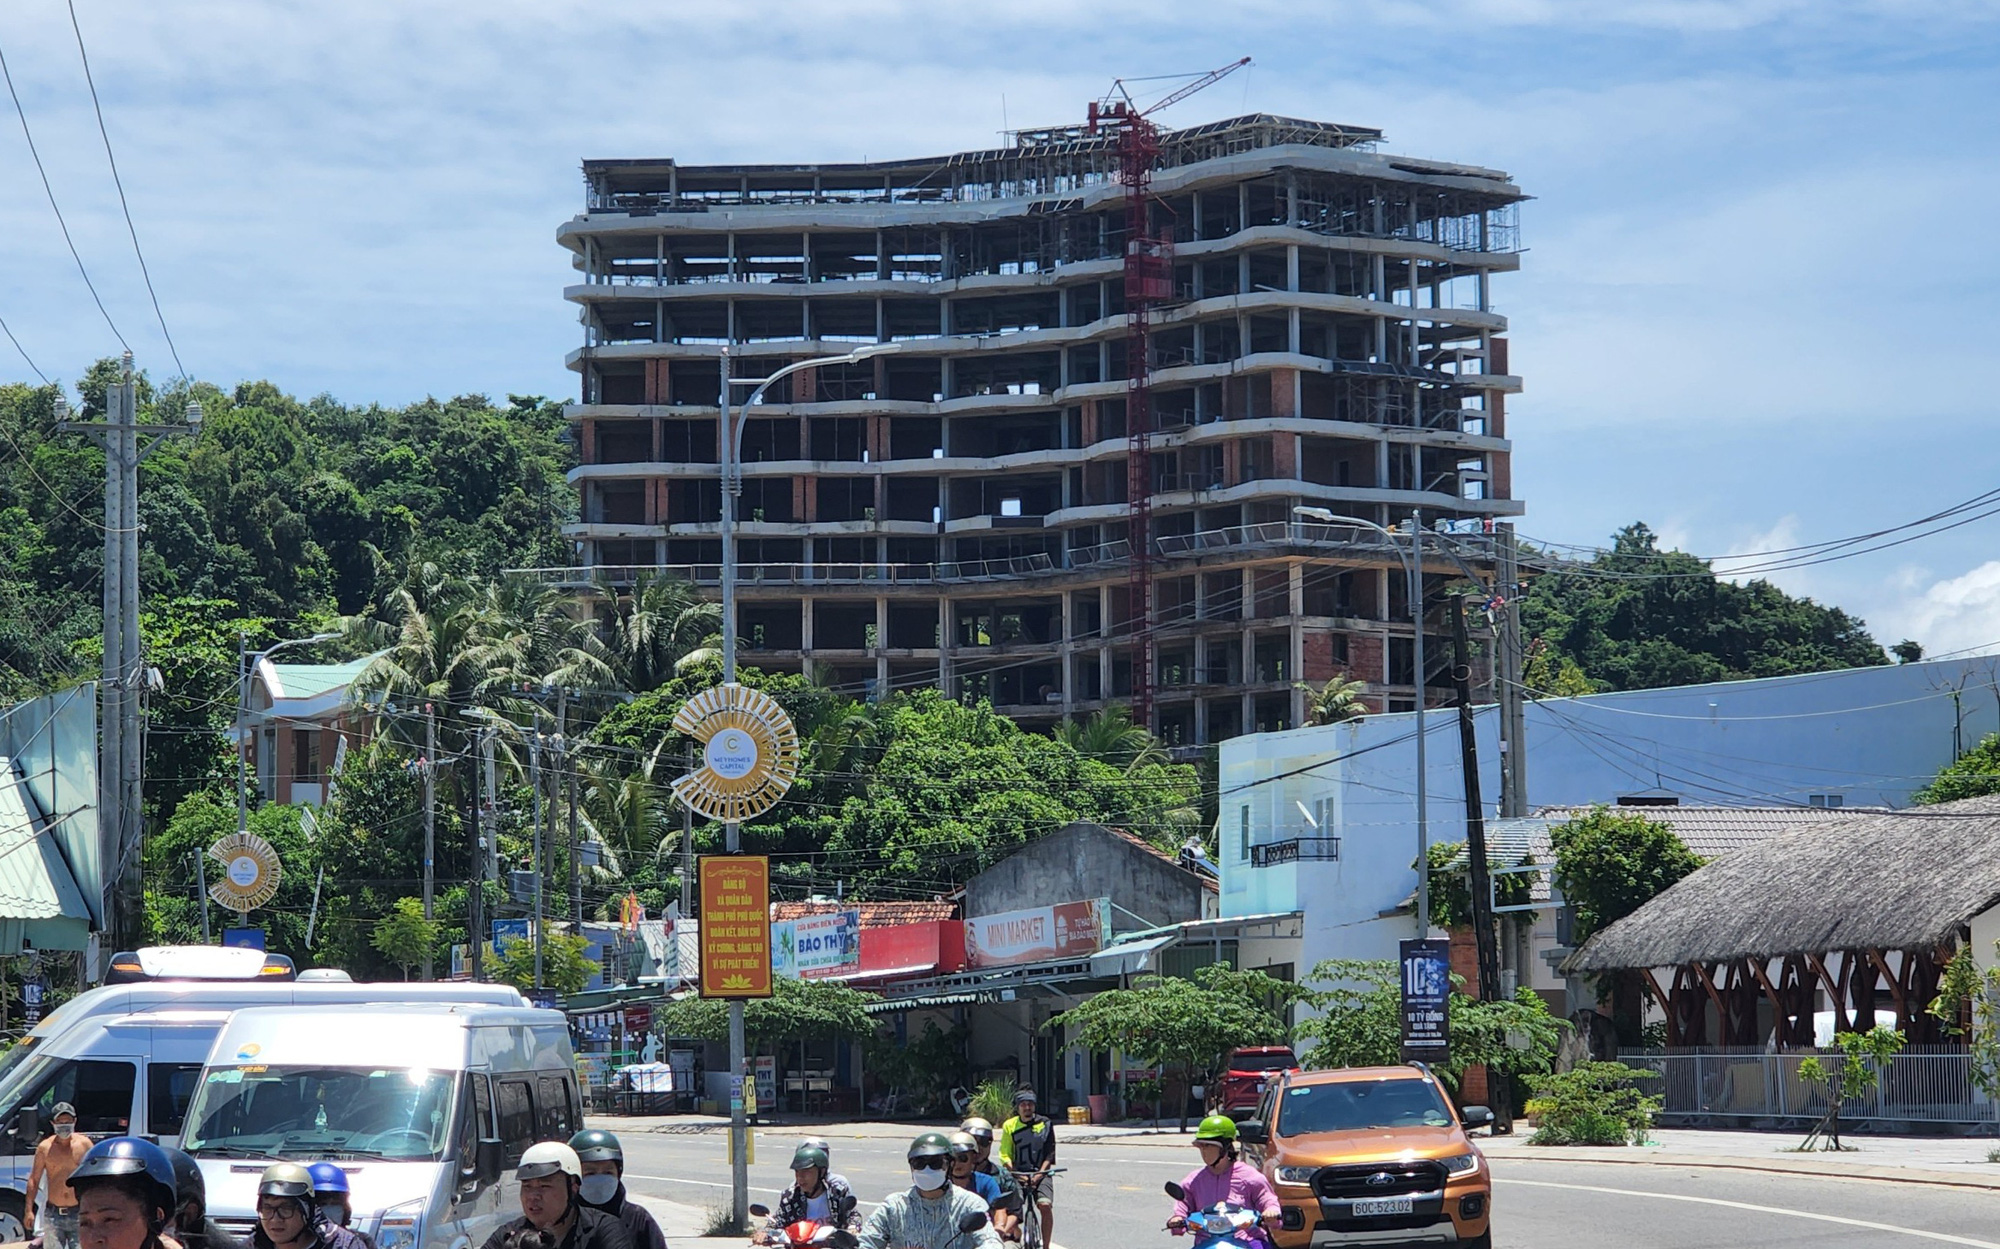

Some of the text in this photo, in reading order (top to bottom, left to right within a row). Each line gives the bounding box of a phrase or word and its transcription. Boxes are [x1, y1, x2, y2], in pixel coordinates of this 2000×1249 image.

[987, 925, 1006, 949] MINI
[1007, 917, 1045, 946] MARKET
[798, 933, 845, 953] BẢO THY
[1407, 1012, 1416, 1022] 10
[757, 1070, 772, 1080] THY
[1355, 1201, 1410, 1215] 60C-523.02
